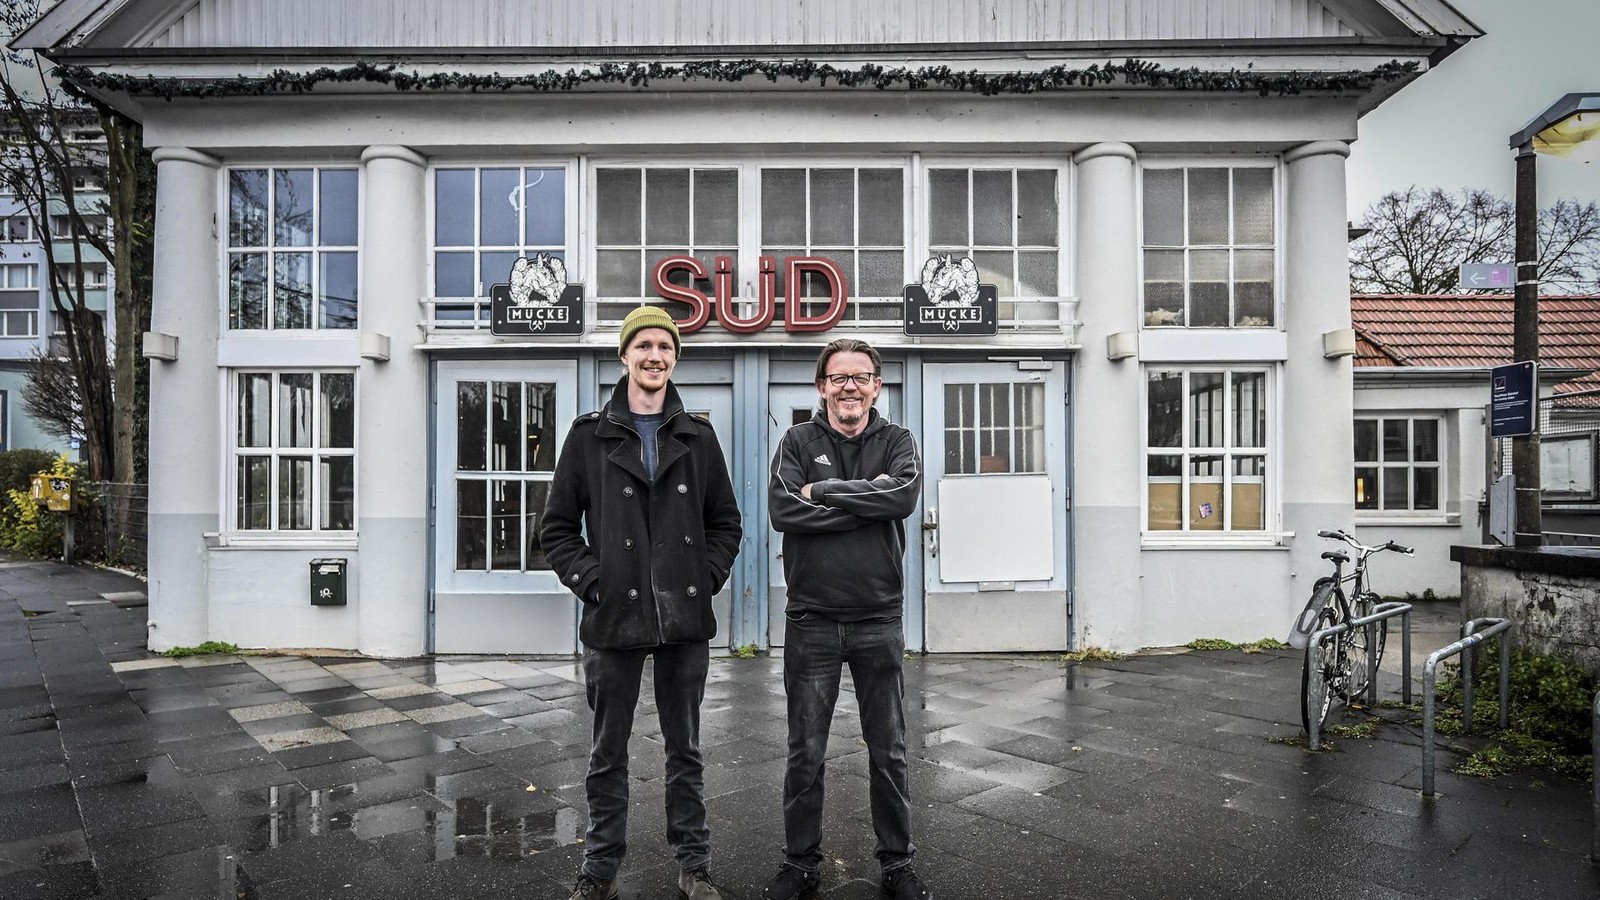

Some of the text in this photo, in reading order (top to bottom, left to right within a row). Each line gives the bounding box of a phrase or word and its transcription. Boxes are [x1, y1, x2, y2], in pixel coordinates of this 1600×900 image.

[653, 255, 848, 333] SÜD
[512, 309, 564, 319] MUCKE
[924, 309, 977, 319] MUCKE
